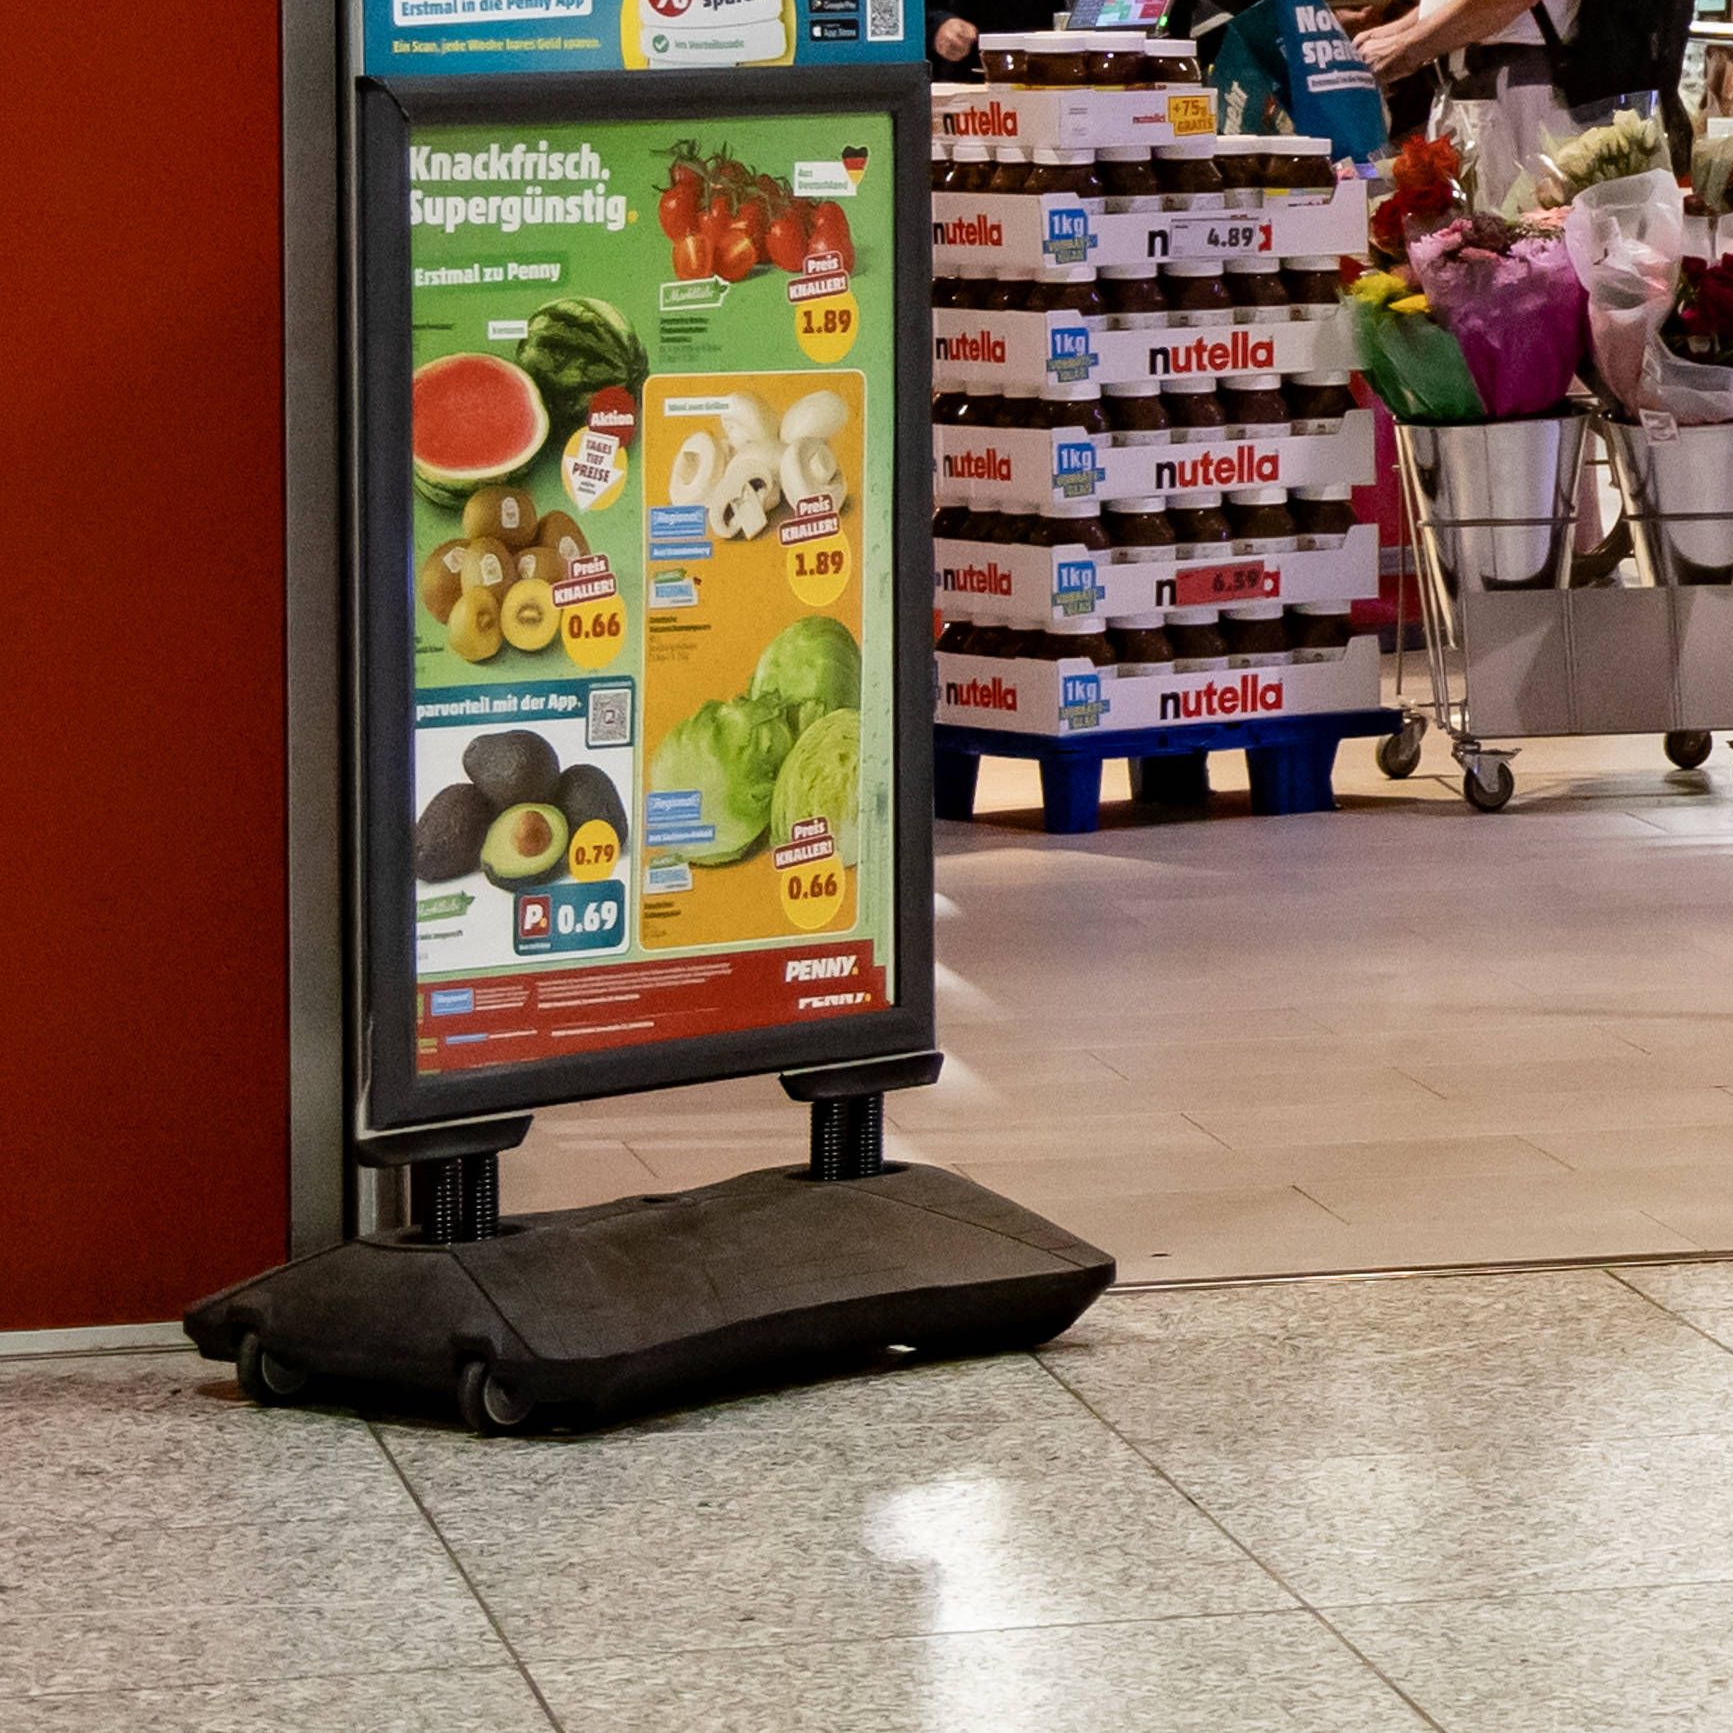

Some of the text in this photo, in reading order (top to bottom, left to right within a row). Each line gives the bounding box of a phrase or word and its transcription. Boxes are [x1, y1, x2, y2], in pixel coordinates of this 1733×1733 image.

[943, 102, 1018, 138] nutella
[409, 141, 610, 183] Knackfrisch.
[409, 187, 638, 233] Supergünstig.
[933, 215, 1003, 247] nutella
[1052, 212, 1086, 240] 1kg
[1206, 226, 1254, 248] 4.89
[414, 262, 561, 286] Erstmal zu Penny
[807, 254, 839, 274] Preis
[801, 308, 853, 335] 1.89
[935, 330, 1006, 364] nutella
[1053, 331, 1087, 358] 1kg
[1148, 331, 1275, 376] nutella
[590, 410, 635, 428] Aktion
[572, 462, 612, 484] PREISE
[943, 447, 1012, 482] nutella
[1058, 447, 1094, 474] 1kg
[1155, 445, 1280, 490] nutella
[800, 498, 831, 517] Preis
[573, 557, 606, 577] Preis
[795, 550, 844, 577] 1.89
[943, 562, 1012, 597] nutella
[1060, 564, 1093, 591] 1kg
[1211, 569, 1260, 592] 6.59
[568, 612, 621, 639] 0.66
[946, 677, 1018, 712] nutella
[1064, 679, 1098, 705] 1kg
[1159, 674, 1284, 721] nutella
[416, 693, 582, 720] parvorteil mit der App.
[794, 820, 826, 840] Preis
[575, 843, 615, 866] 0.79
[788, 872, 838, 901] 0.66
[557, 900, 619, 935] 0.69
[785, 955, 859, 983] PENNY.
